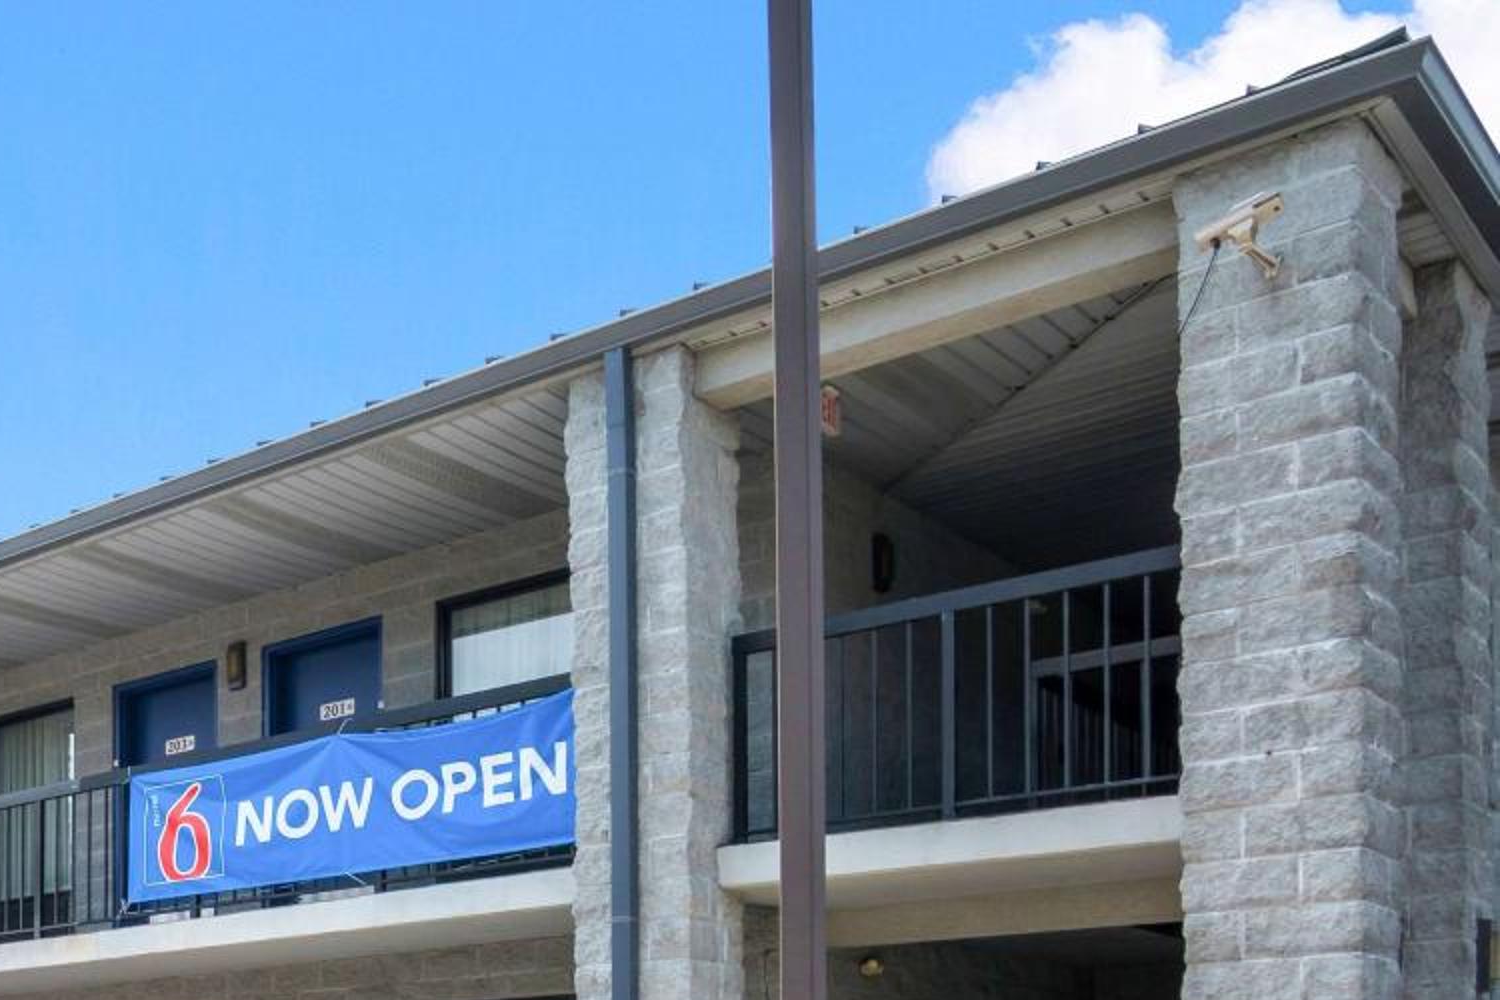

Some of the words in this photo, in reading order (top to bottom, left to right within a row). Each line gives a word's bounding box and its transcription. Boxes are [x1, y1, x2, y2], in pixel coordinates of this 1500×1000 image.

[158, 782, 212, 882] 6
[234, 777, 373, 847] NOW
[391, 741, 568, 821] OPEN
